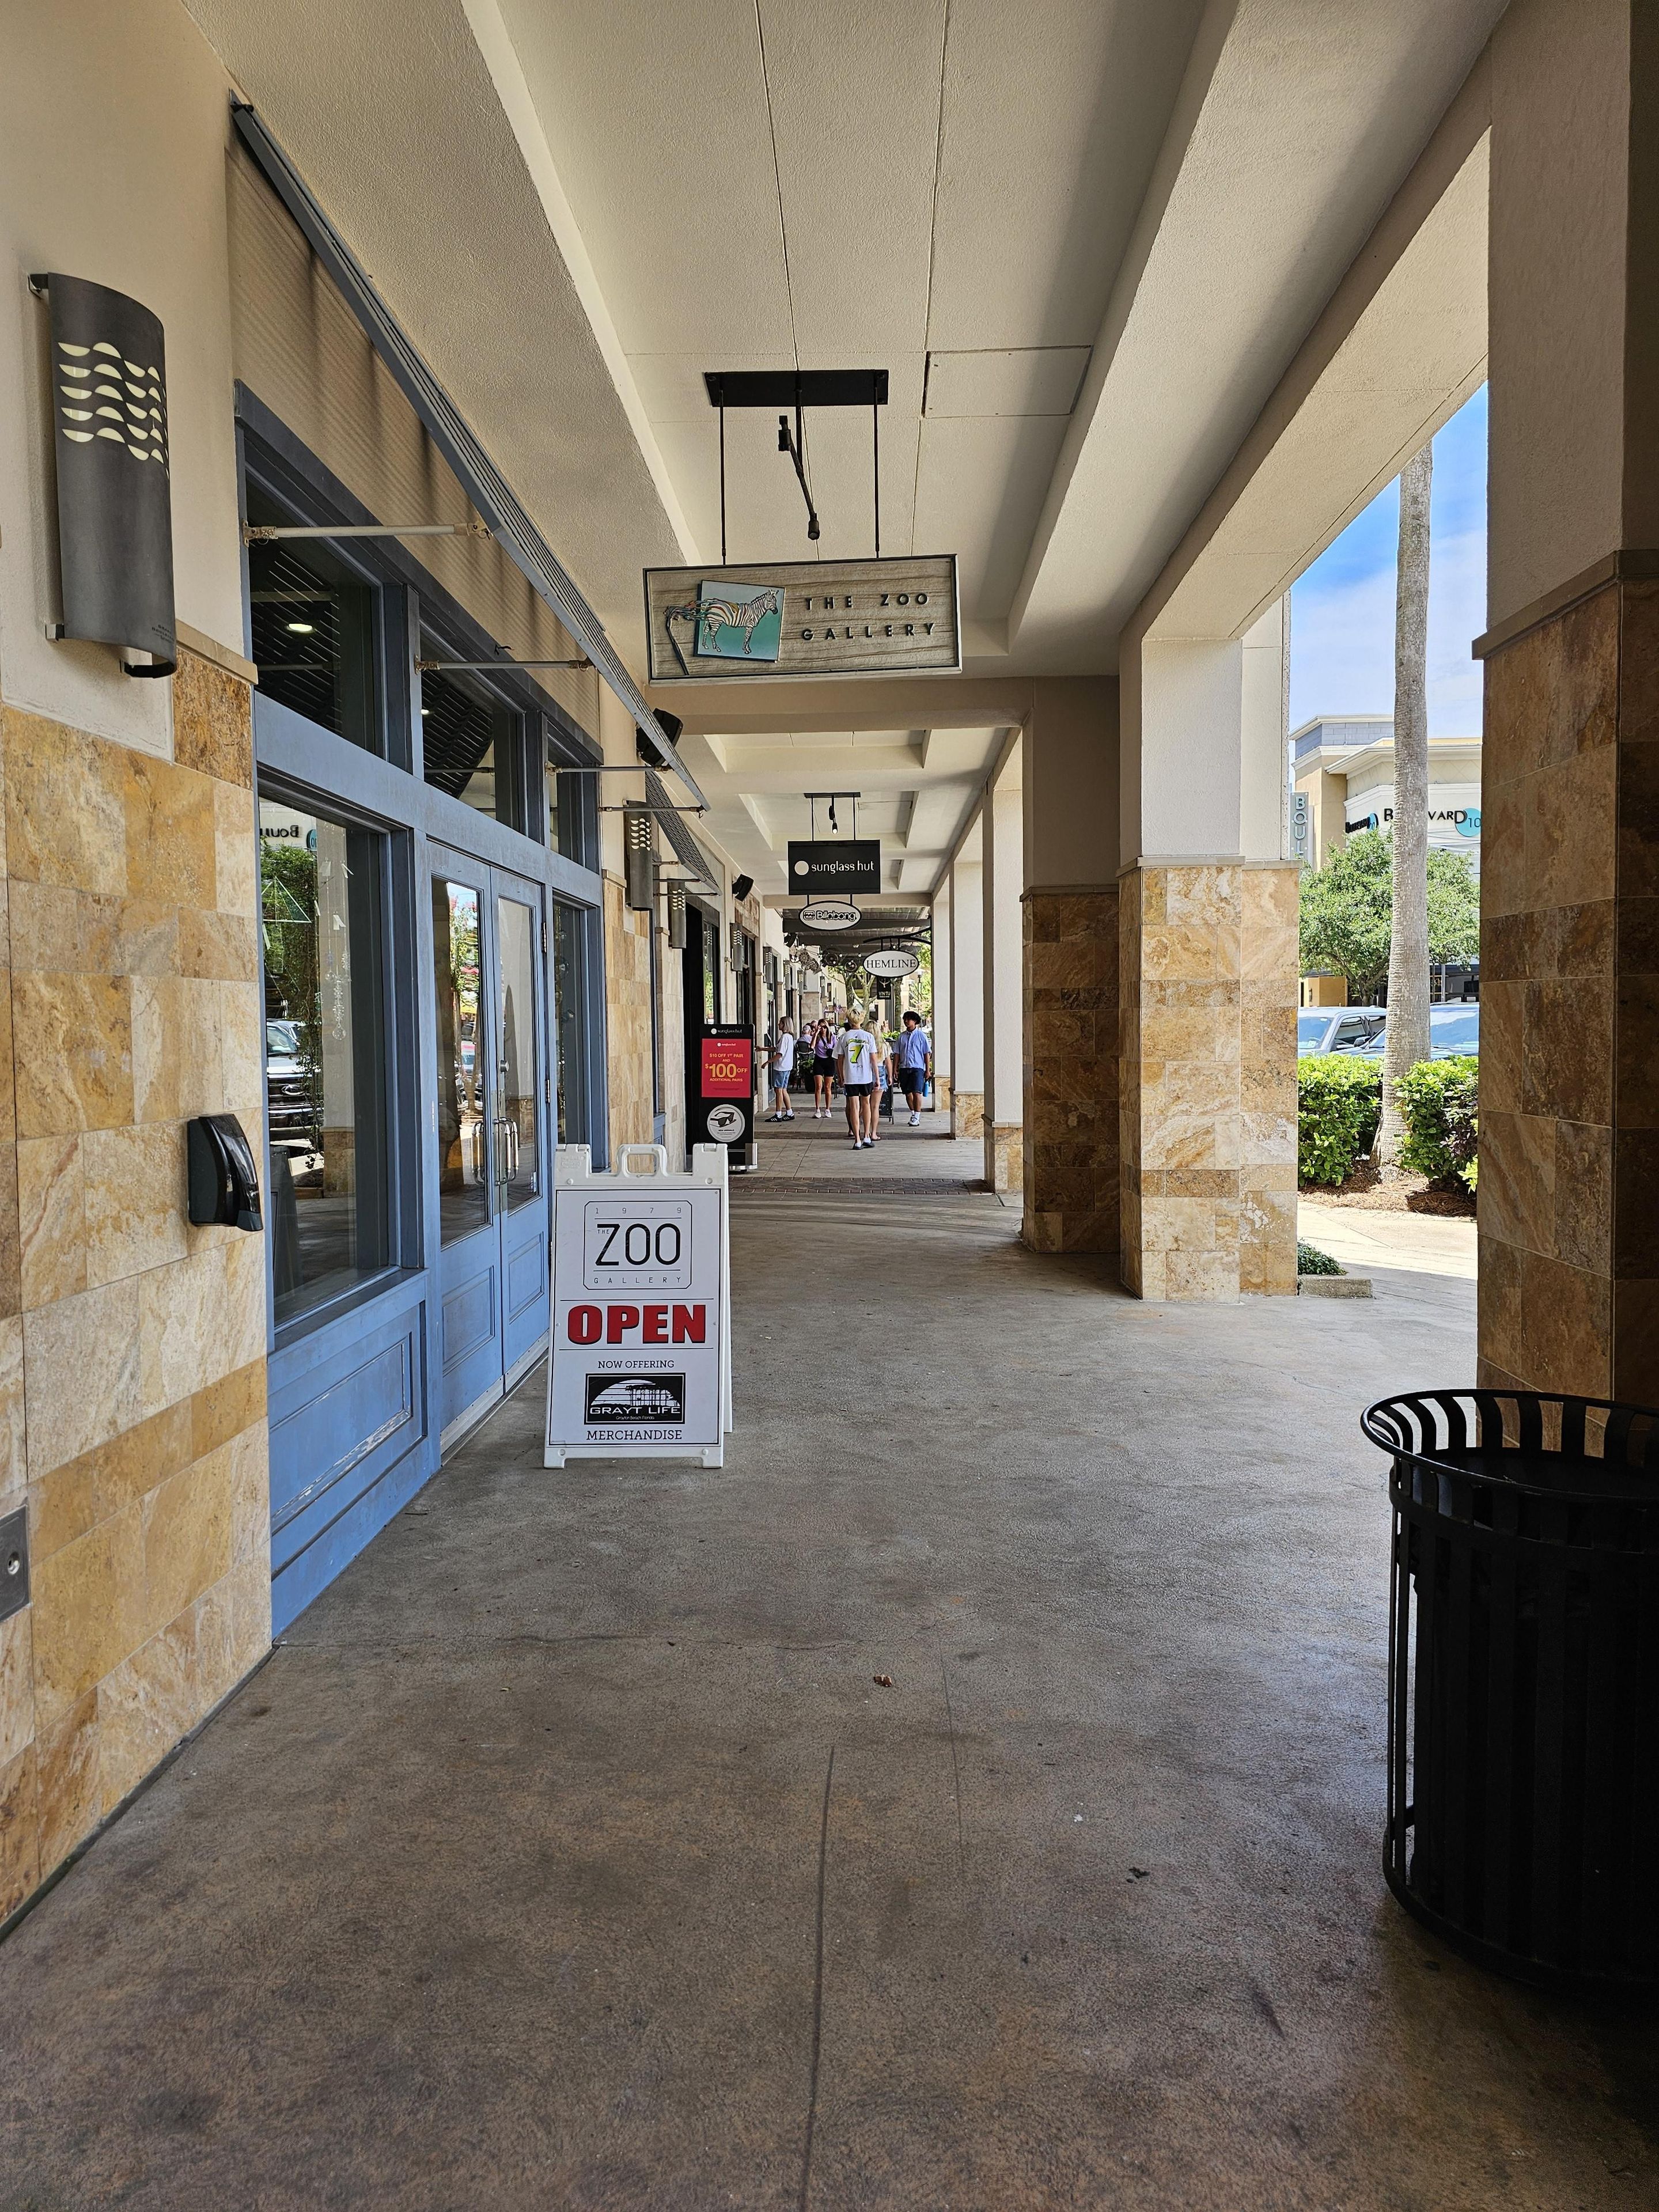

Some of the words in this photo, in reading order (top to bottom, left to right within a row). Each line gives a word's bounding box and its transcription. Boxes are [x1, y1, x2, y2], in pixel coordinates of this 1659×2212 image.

[805, 596, 854, 611] THE
[880, 593, 929, 607] ZOO
[801, 622, 934, 641] GALLERY
[811, 861, 855, 874] sunglass
[857, 860, 874, 871] hut
[866, 959, 917, 969] HEMLINE
[849, 1044, 864, 1064] 7
[595, 1223, 681, 1266] ZOO
[567, 1304, 706, 1346] OPEN
[597, 1360, 623, 1369] NOW
[625, 1360, 675, 1369] OFFERING
[590, 1407, 642, 1415] GRAYT
[648, 1406, 681, 1414] LIFE
[586, 1430, 682, 1441] MERCHANDISE
